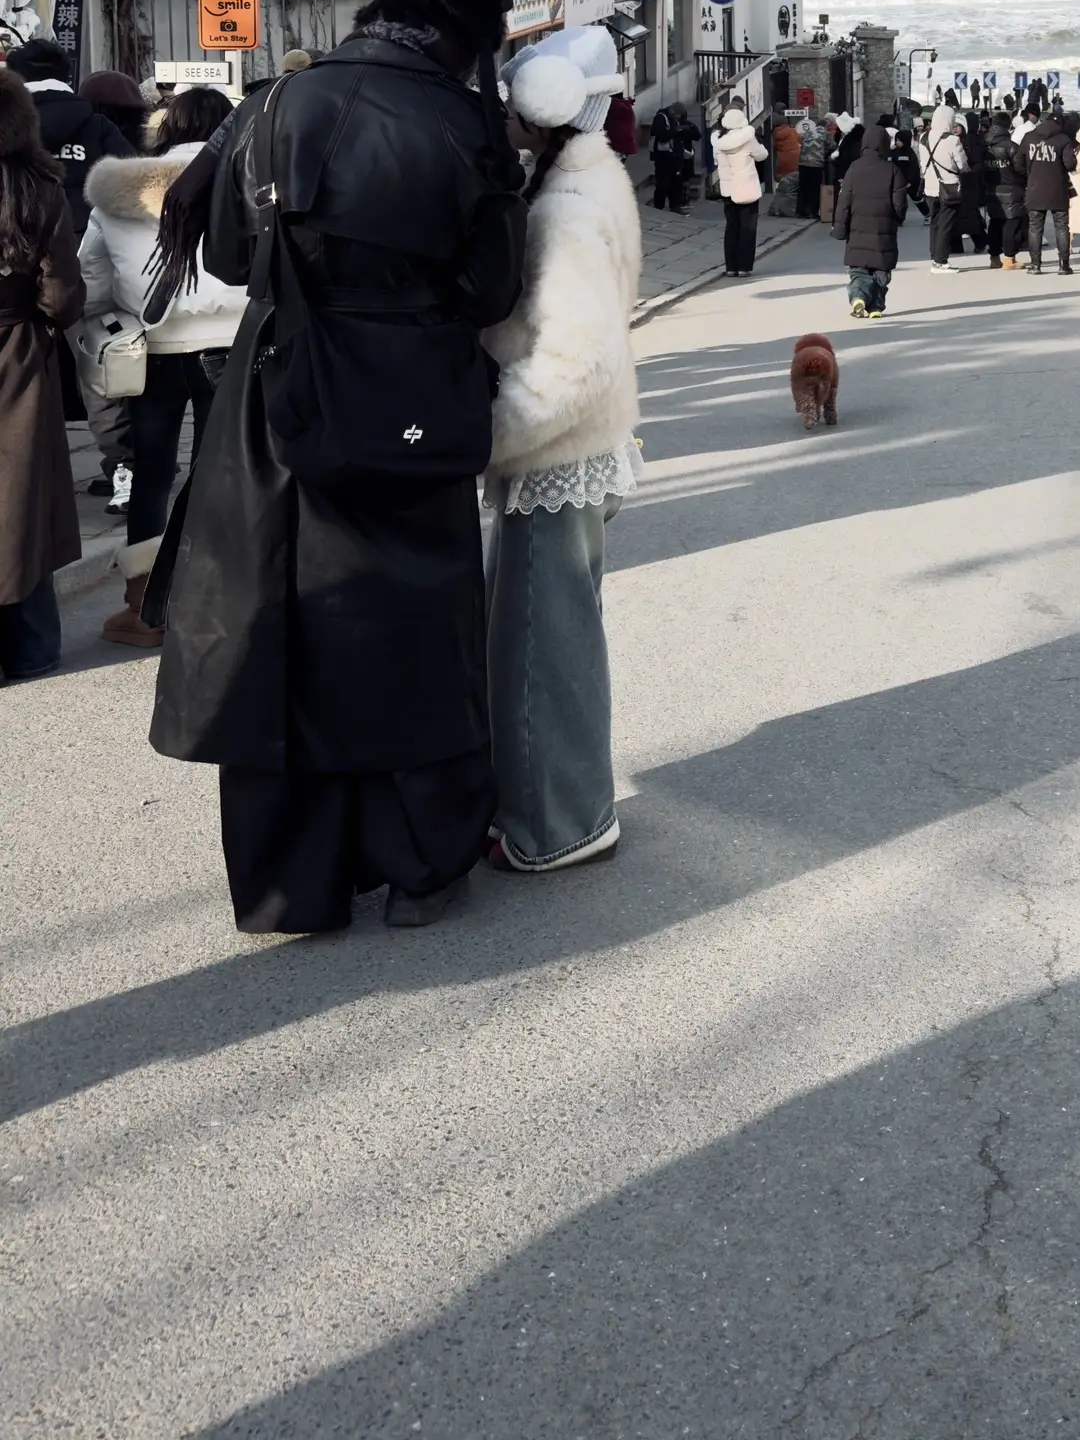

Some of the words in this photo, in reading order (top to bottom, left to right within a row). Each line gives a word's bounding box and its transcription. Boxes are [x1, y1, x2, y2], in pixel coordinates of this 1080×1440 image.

[218, 0, 251, 10] smile
[230, 35, 248, 43] Stay
[185, 68, 201, 78] SEE
[203, 68, 222, 78] SEA
[53, 144, 86, 161] ES
